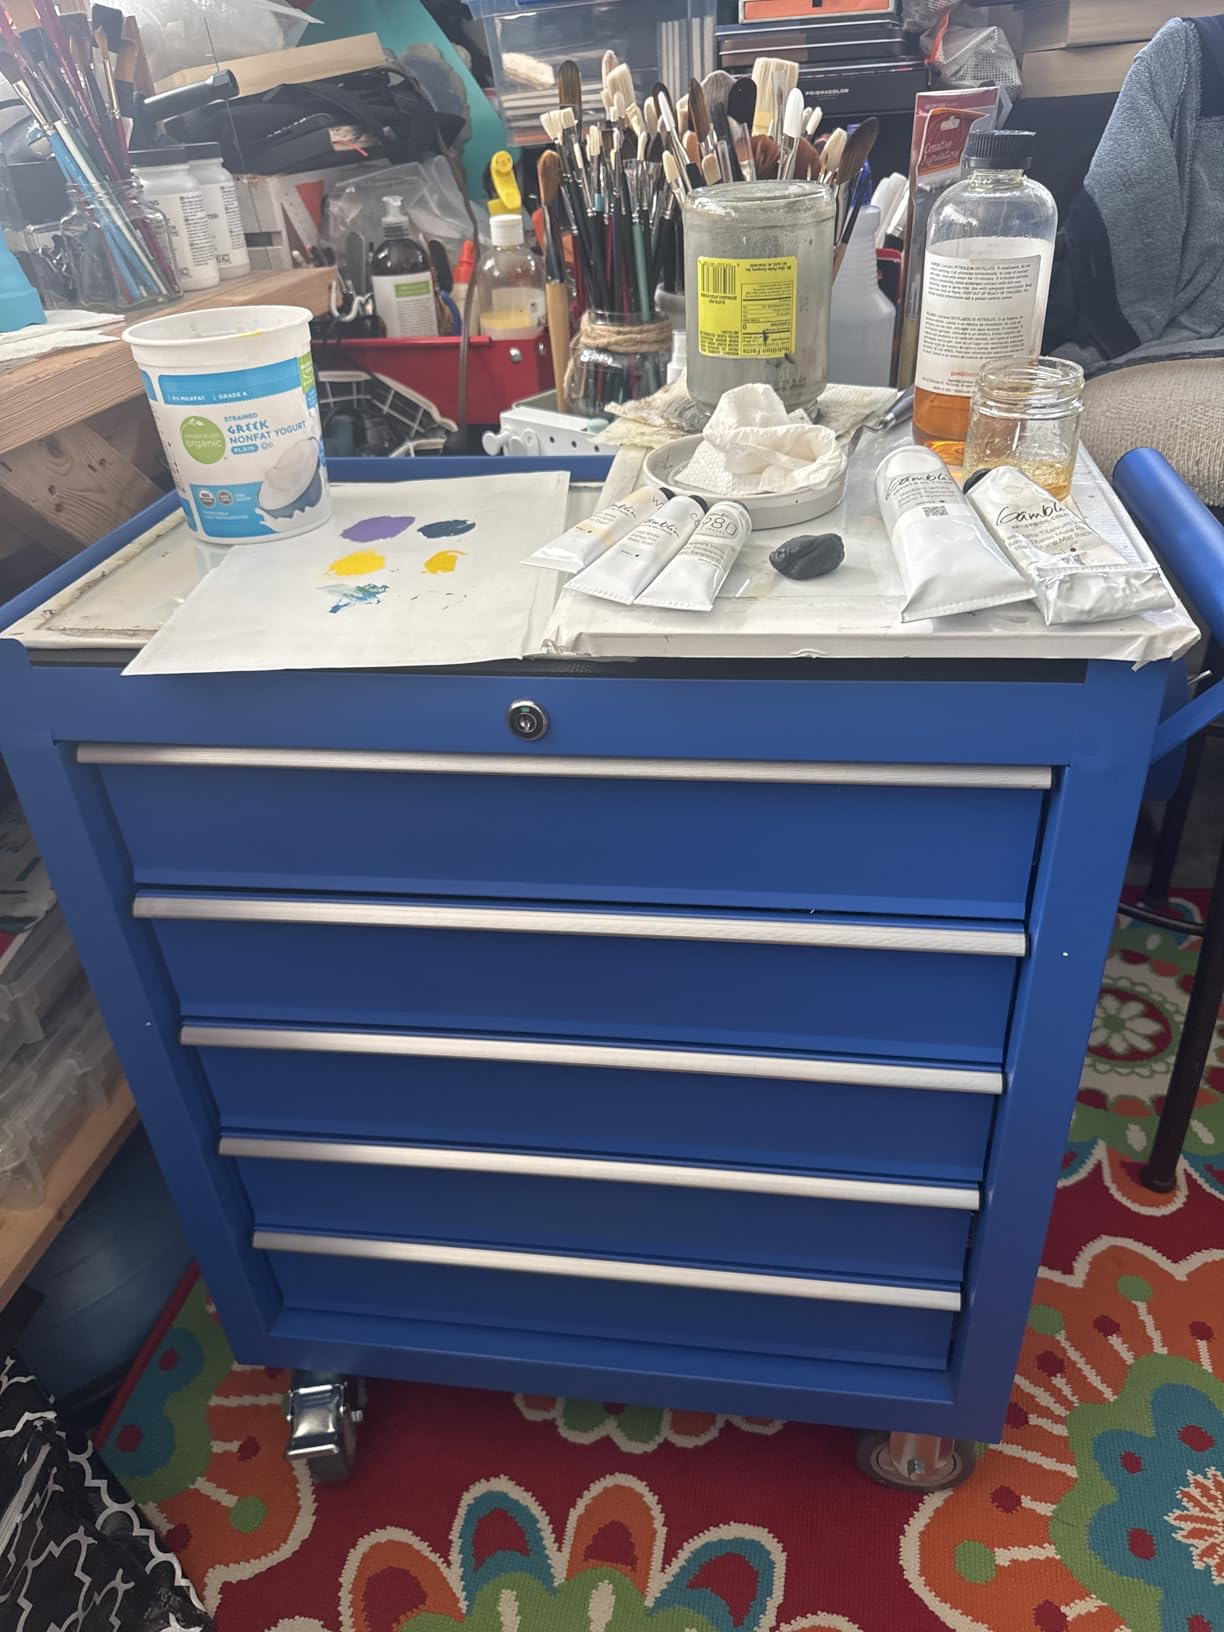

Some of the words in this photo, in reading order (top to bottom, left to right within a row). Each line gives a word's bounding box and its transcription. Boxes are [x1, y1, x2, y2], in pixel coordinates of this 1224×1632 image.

[224, 412, 258, 422] STRAINED
[228, 420, 270, 434] GREEK
[230, 430, 272, 444] NONFAT
[274, 420, 306, 437] YOGURT
[185, 440, 222, 449] organic
